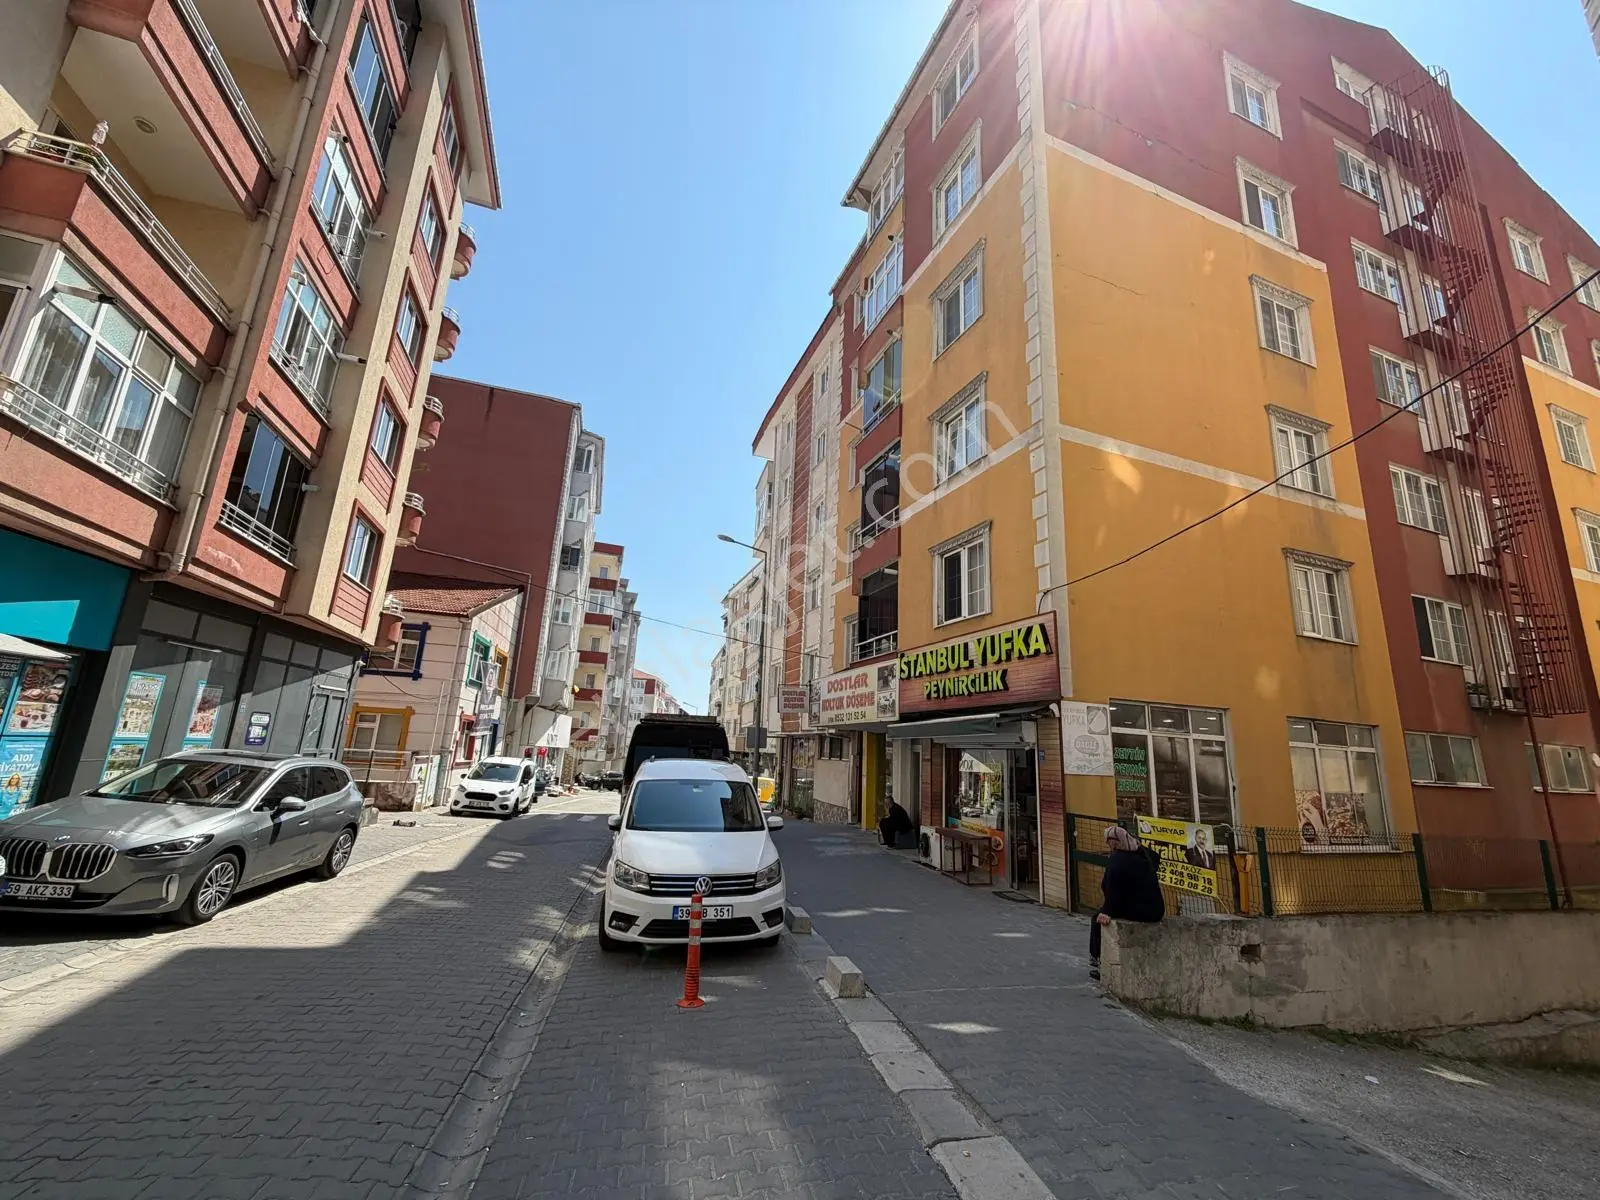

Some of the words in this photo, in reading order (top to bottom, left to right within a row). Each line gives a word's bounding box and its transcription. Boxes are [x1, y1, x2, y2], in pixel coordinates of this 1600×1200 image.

[973, 623, 1049, 667] YUFKA
[827, 672, 868, 694] DOSTLAR
[845, 691, 875, 709] DÖŞEME
[11, 754, 34, 763] A101
[1151, 825, 1185, 836] TURYAP
[1169, 876, 1185, 887] 120
[1187, 881, 1199, 890] 08
[1201, 885, 1213, 895] 28
[1202, 876, 1213, 886] 18
[7, 884, 21, 894] 59
[26, 885, 49, 896] AKZ
[50, 886, 72, 896] 333
[679, 908, 691, 919] 39
[713, 907, 731, 918] 351
